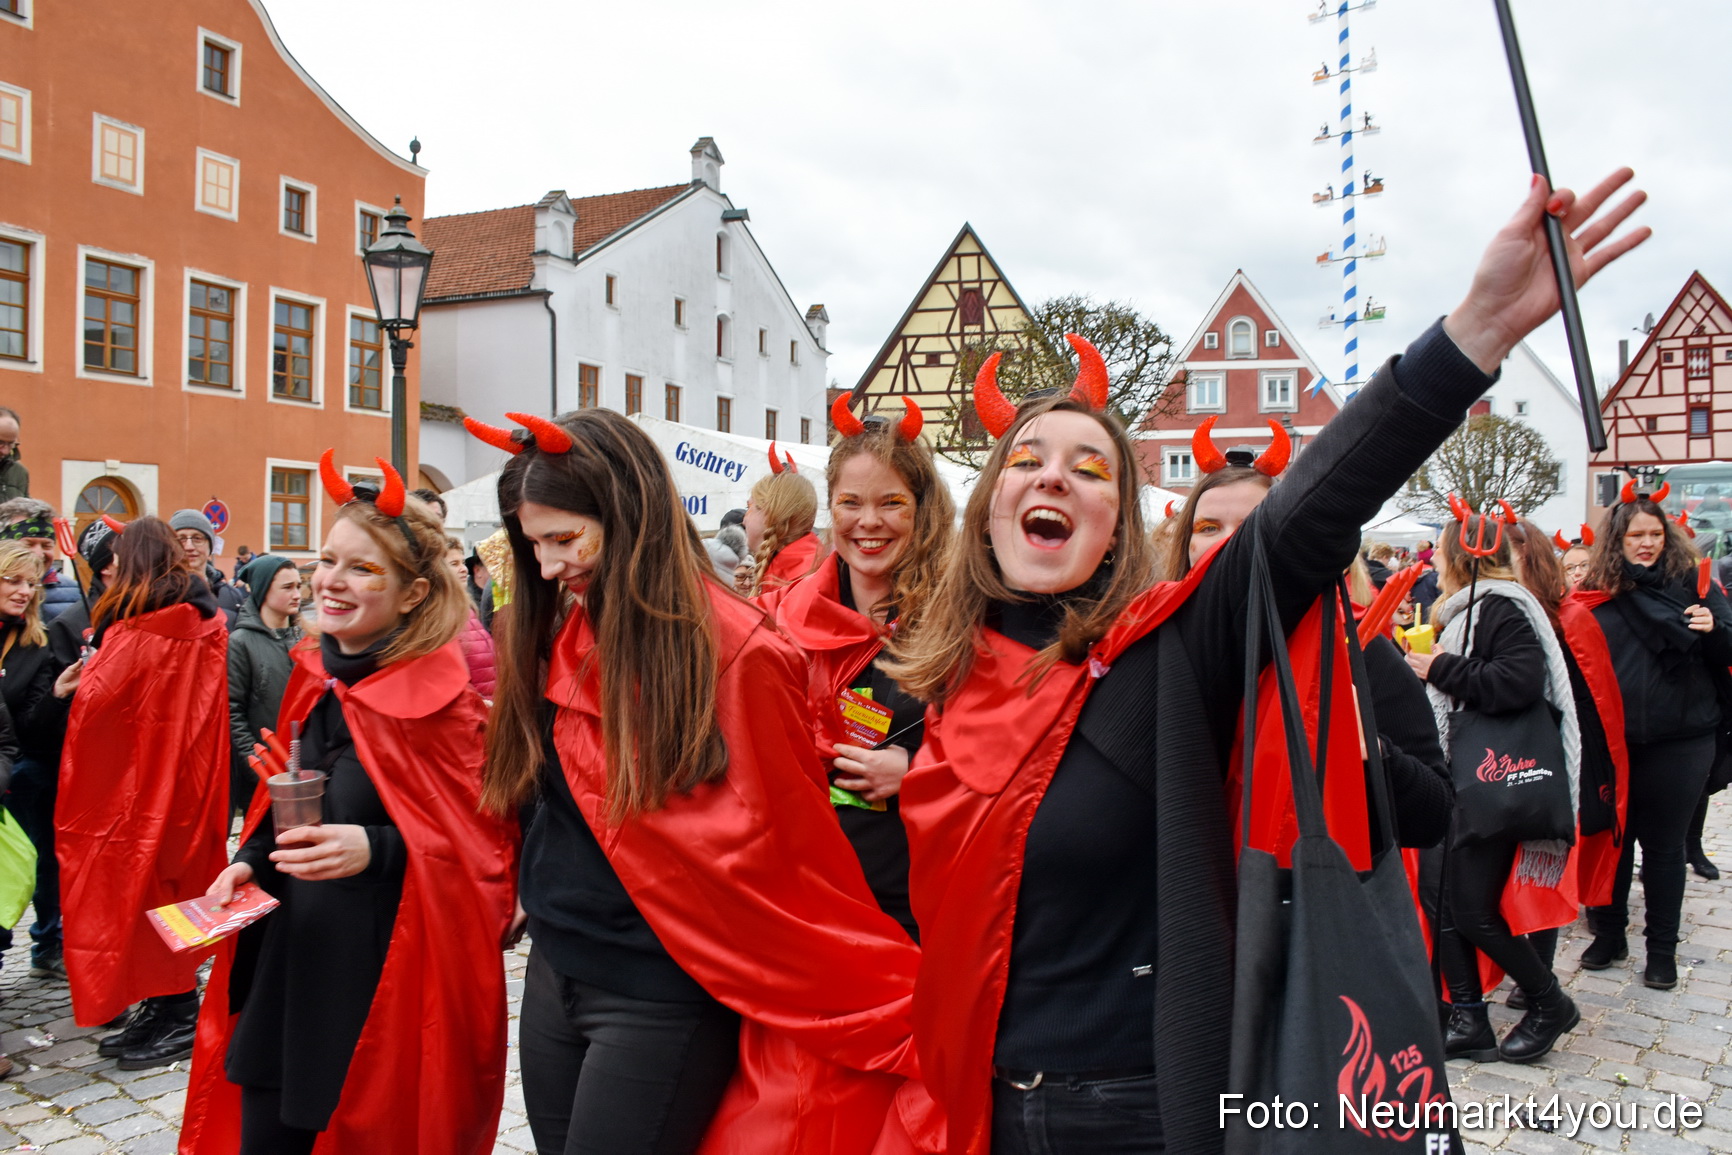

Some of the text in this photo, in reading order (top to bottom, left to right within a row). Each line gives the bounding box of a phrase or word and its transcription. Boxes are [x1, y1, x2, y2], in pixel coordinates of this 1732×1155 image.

[675, 441, 748, 483] Gschrey
[1493, 757, 1537, 781] Jahre
[1507, 773, 1518, 781] FF
[1390, 1044, 1423, 1074] 125
